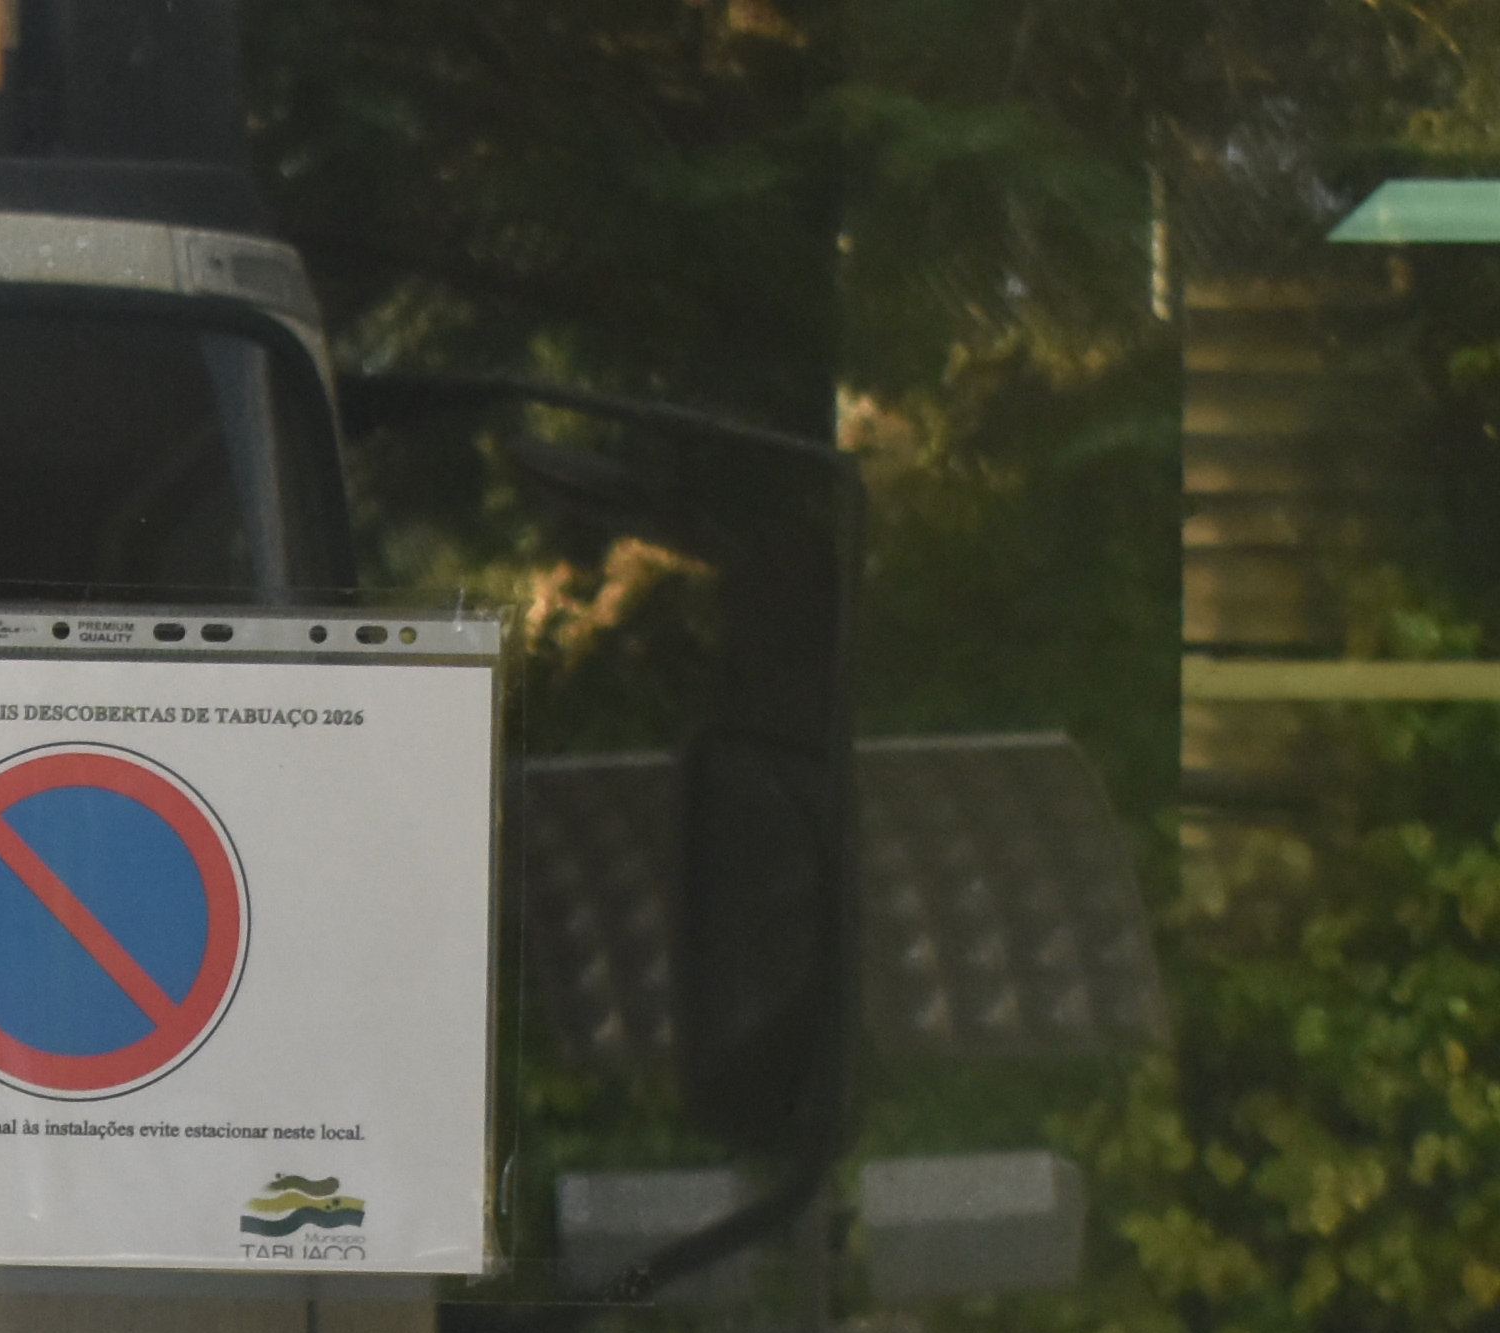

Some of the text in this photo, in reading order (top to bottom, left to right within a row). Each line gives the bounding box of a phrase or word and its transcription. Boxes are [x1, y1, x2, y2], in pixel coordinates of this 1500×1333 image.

[78, 621, 134, 631] PREMIUM
[79, 632, 132, 642] QUALITY
[24, 705, 176, 723] DESCOBERTAS
[181, 707, 210, 724] DE
[215, 708, 318, 728] TABUAÇO
[322, 709, 364, 725] 2026
[22, 1120, 39, 1136] às
[45, 1120, 134, 1140] instalações
[140, 1121, 179, 1138] evite
[185, 1122, 269, 1139] estacionar
[273, 1126, 316, 1140] neste
[321, 1123, 365, 1141] local.
